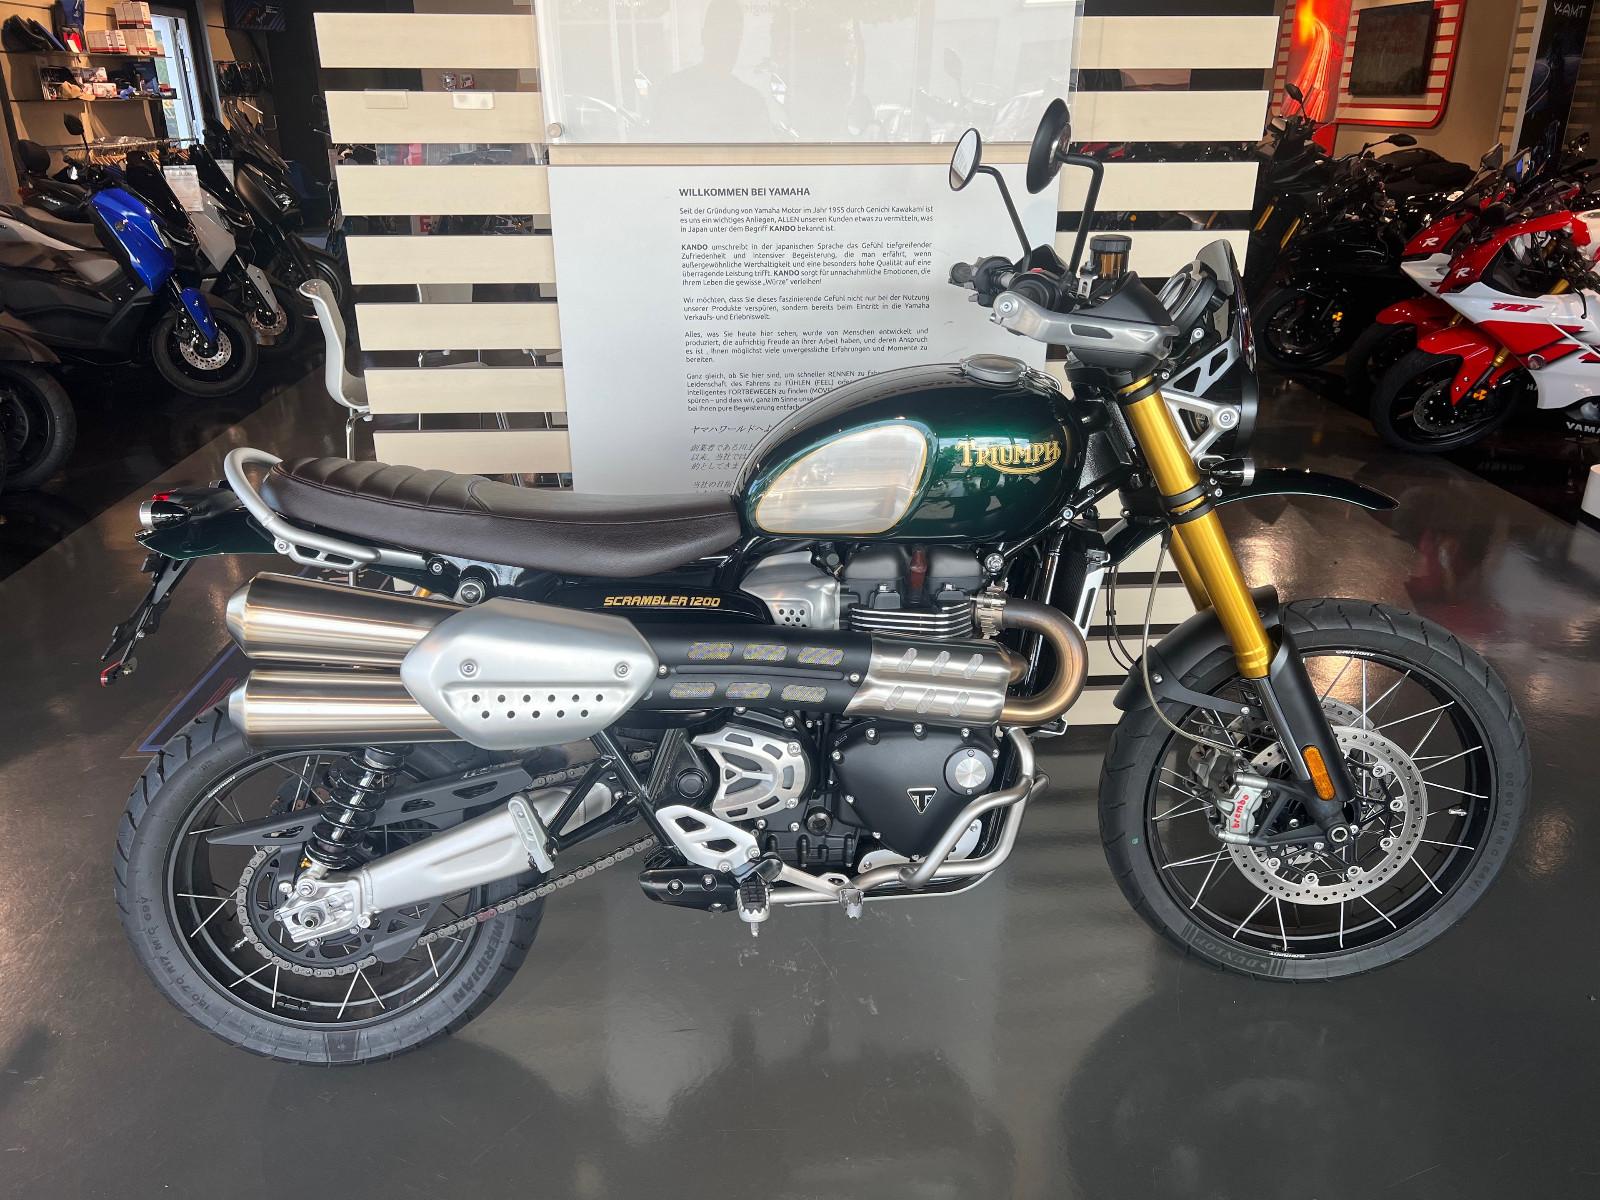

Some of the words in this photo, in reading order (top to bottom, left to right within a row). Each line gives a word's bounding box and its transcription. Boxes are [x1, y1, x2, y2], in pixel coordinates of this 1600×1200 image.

[1553, 2, 1587, 18] Y-AMT
[678, 188, 749, 196] WILLKOMMEN
[750, 188, 767, 196] BEI
[768, 187, 811, 196] YAMAHA
[706, 207, 740, 216] Gründung
[812, 206, 828, 214] Jahr
[712, 216, 745, 225] wichtiges
[687, 226, 708, 234] Japan
[744, 225, 768, 233] Begriff
[775, 242, 815, 251] japanischen
[817, 242, 844, 251] Sprache
[886, 241, 932, 250] tiefgreifender
[681, 261, 742, 270] außergewöhnliche
[743, 260, 791, 269] Werthaltigkeit
[822, 259, 857, 267] besonders
[682, 270, 725, 278] überragende
[724, 269, 754, 278] Leistung
[800, 269, 818, 277] sorgt
[735, 278, 762, 287] gewisse
[902, 293, 930, 302] Nutzung
[683, 313, 715, 321] Verkaufs-
[734, 338, 766, 347] aufrichtig
[897, 336, 928, 344] Anspruch
[731, 347, 762, 356] möglichst
[782, 345, 829, 355] unvergessliche
[831, 345, 871, 354] Erfahrungen
[955, 439, 1062, 471] TRIUMPH
[603, 596, 687, 607] SCRAMBLER
[690, 597, 721, 608] 1200
[1231, 794, 1250, 829] brembo
[1193, 936, 1261, 969] DUNLOP
[451, 919, 505, 1004] MERIDIAN
